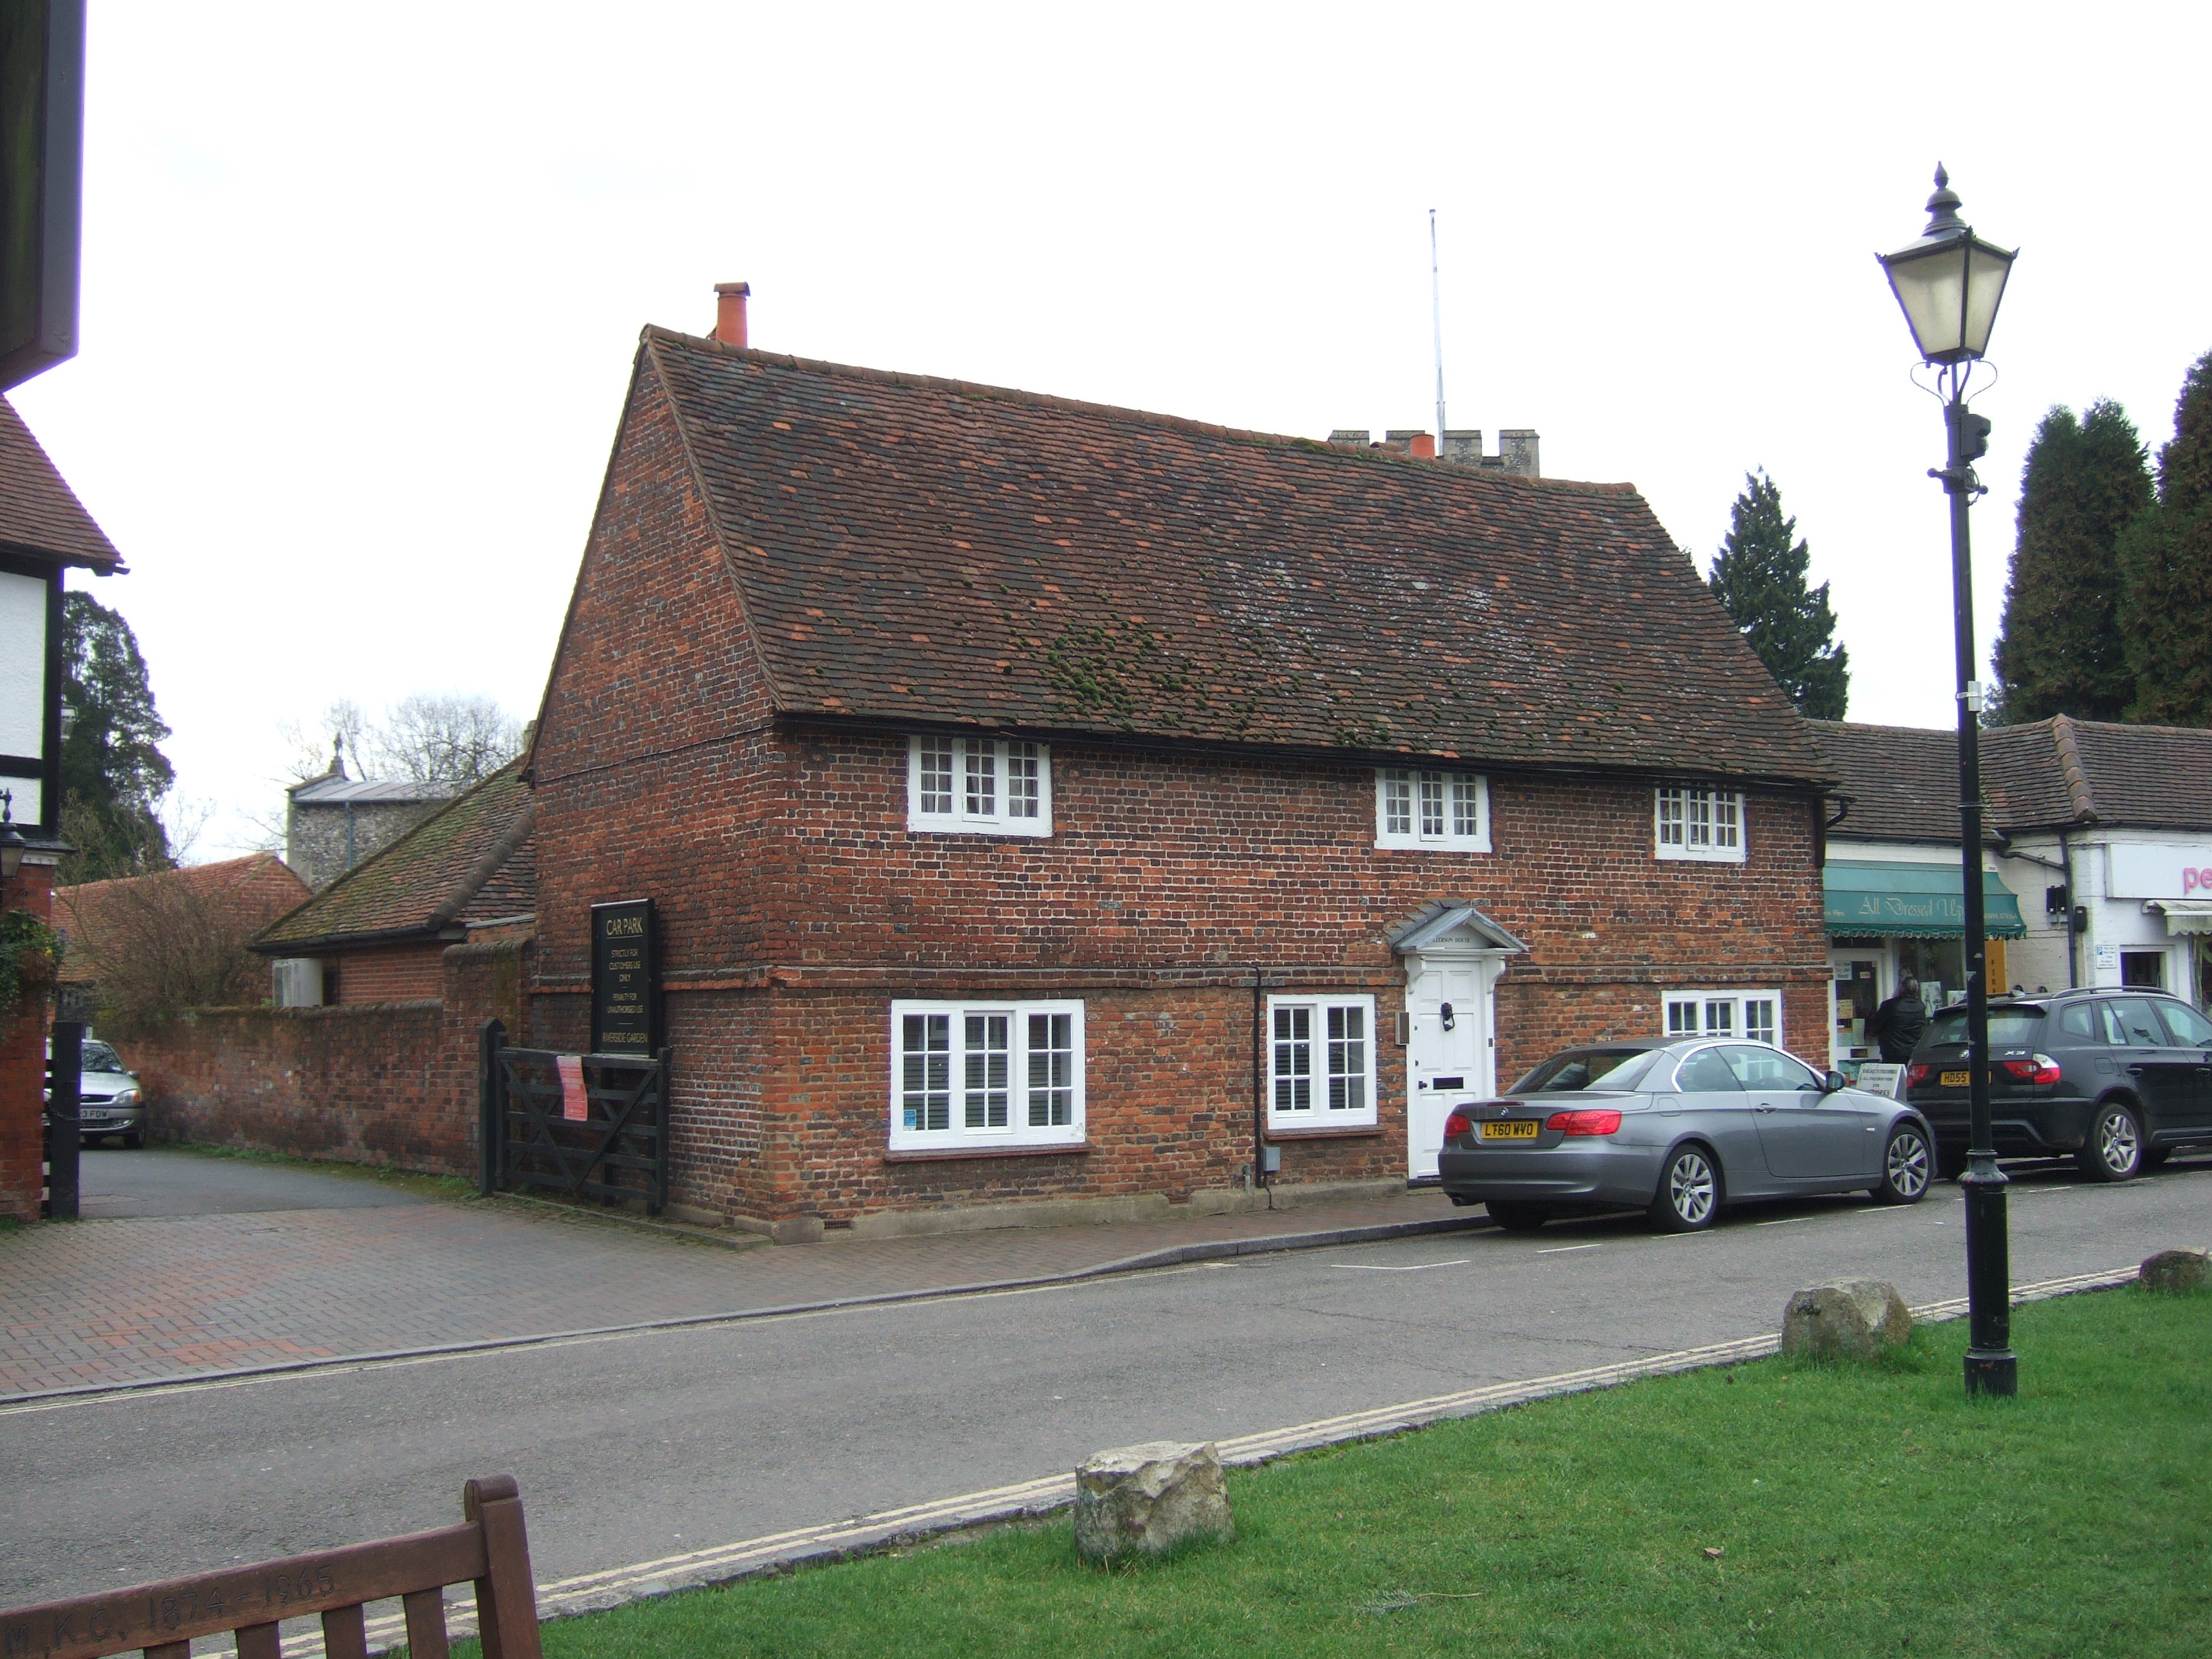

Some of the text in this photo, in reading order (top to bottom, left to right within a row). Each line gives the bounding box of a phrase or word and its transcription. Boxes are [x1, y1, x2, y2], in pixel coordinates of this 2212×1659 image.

[1859, 896, 1964, 922] All Dressed Up
[607, 917, 643, 936] CAR PARK
[611, 949, 629, 958] STRICTLY
[620, 974, 631, 983] ONLY
[603, 1032, 648, 1043] RIVERSIDE GARDEN
[1944, 1073, 1967, 1082] HD55
[1484, 1122, 1533, 1136] LT60 WVO
